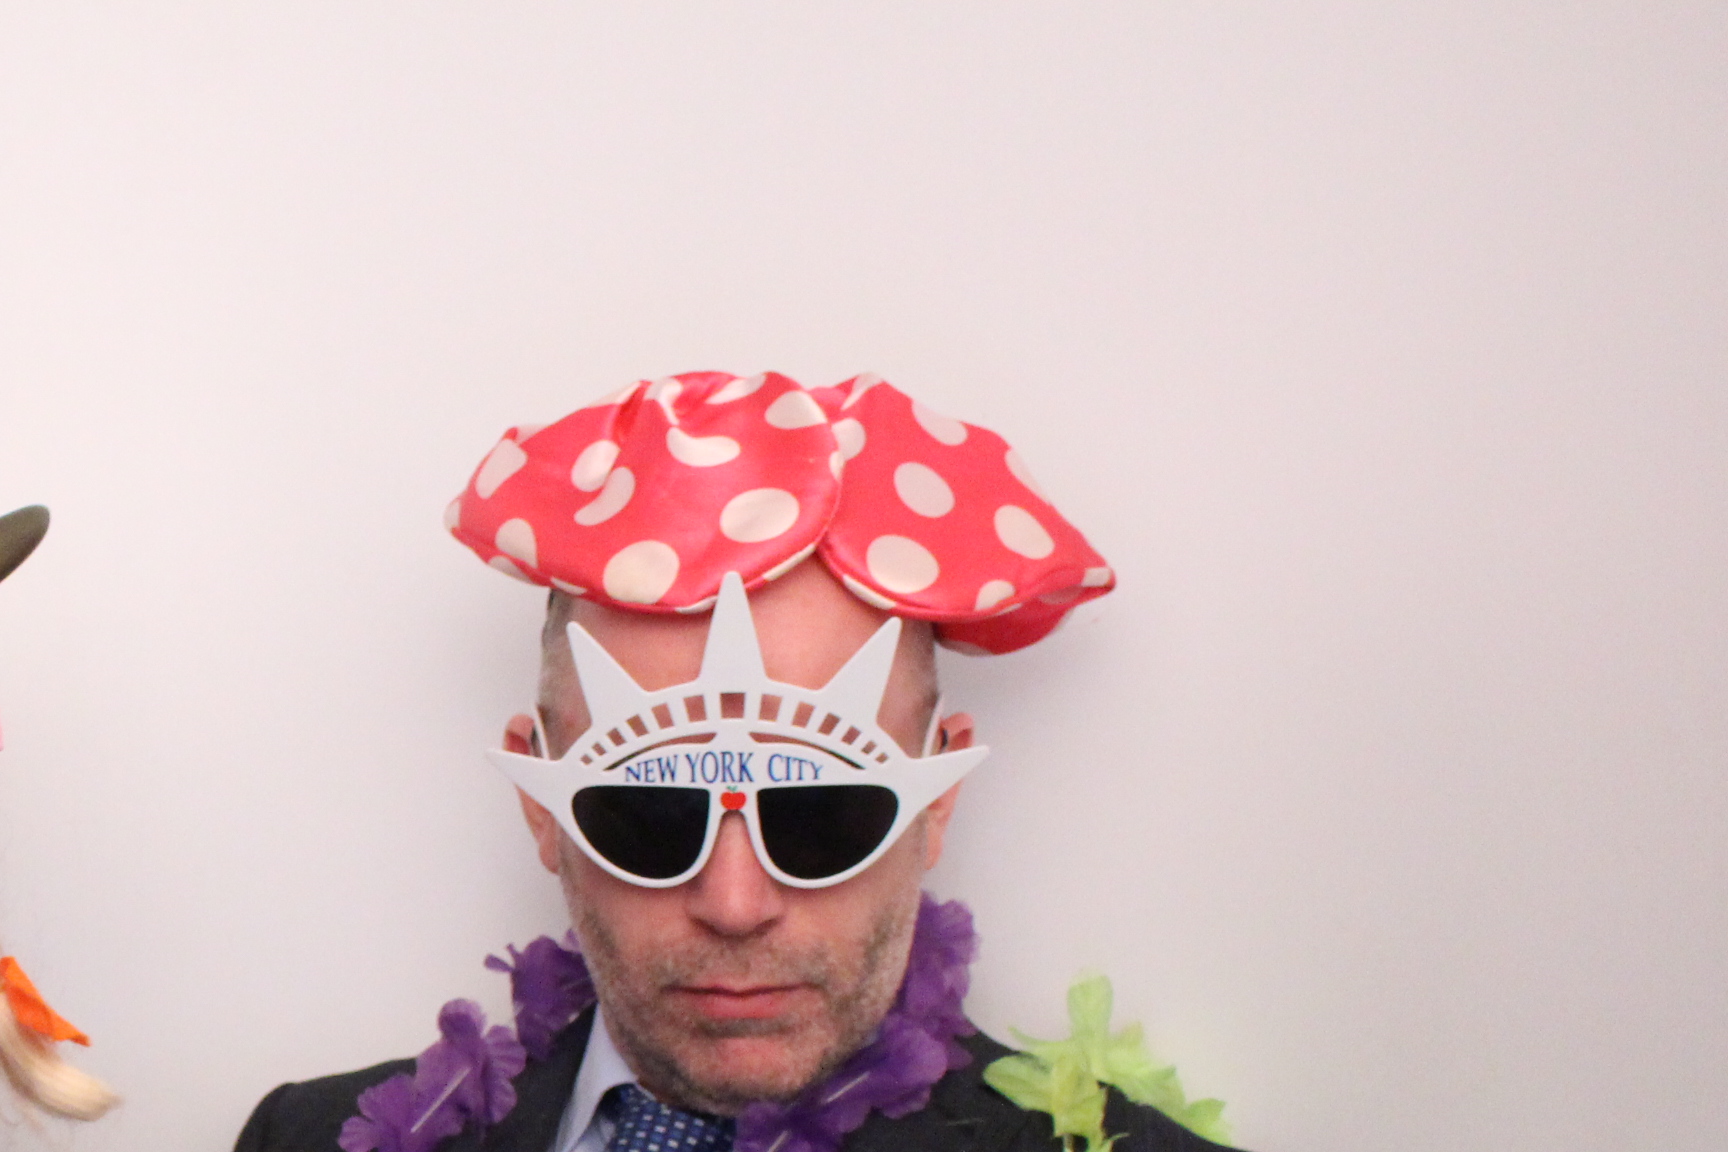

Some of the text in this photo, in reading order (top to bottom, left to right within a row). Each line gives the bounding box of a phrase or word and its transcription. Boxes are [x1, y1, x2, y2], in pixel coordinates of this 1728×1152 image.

[625, 751, 824, 783] NEW YORK CITY
